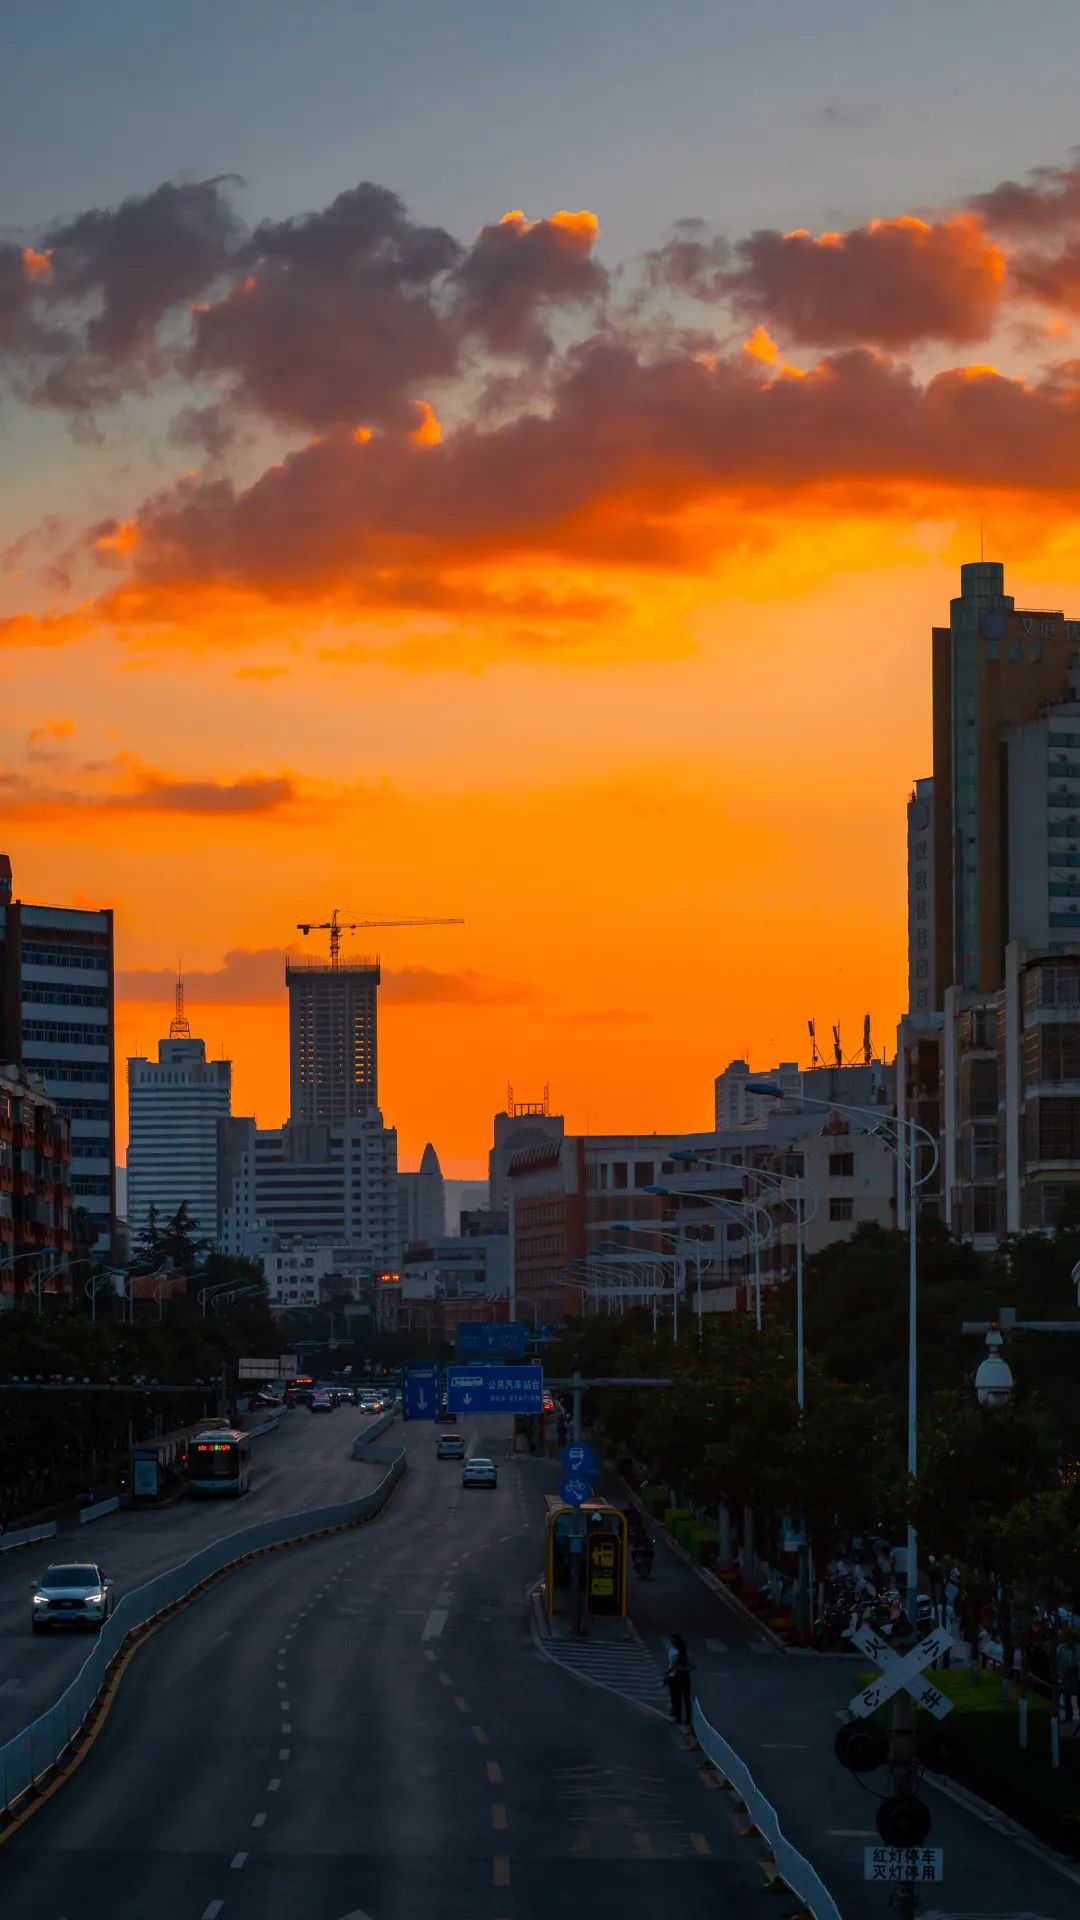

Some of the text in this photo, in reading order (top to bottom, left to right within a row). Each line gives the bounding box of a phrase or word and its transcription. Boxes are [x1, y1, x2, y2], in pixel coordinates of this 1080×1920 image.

[488, 1379, 540, 1390] 公共汽车站台
[873, 1848, 935, 1863] 红灯停车
[873, 1865, 935, 1880] 灭灯停用
